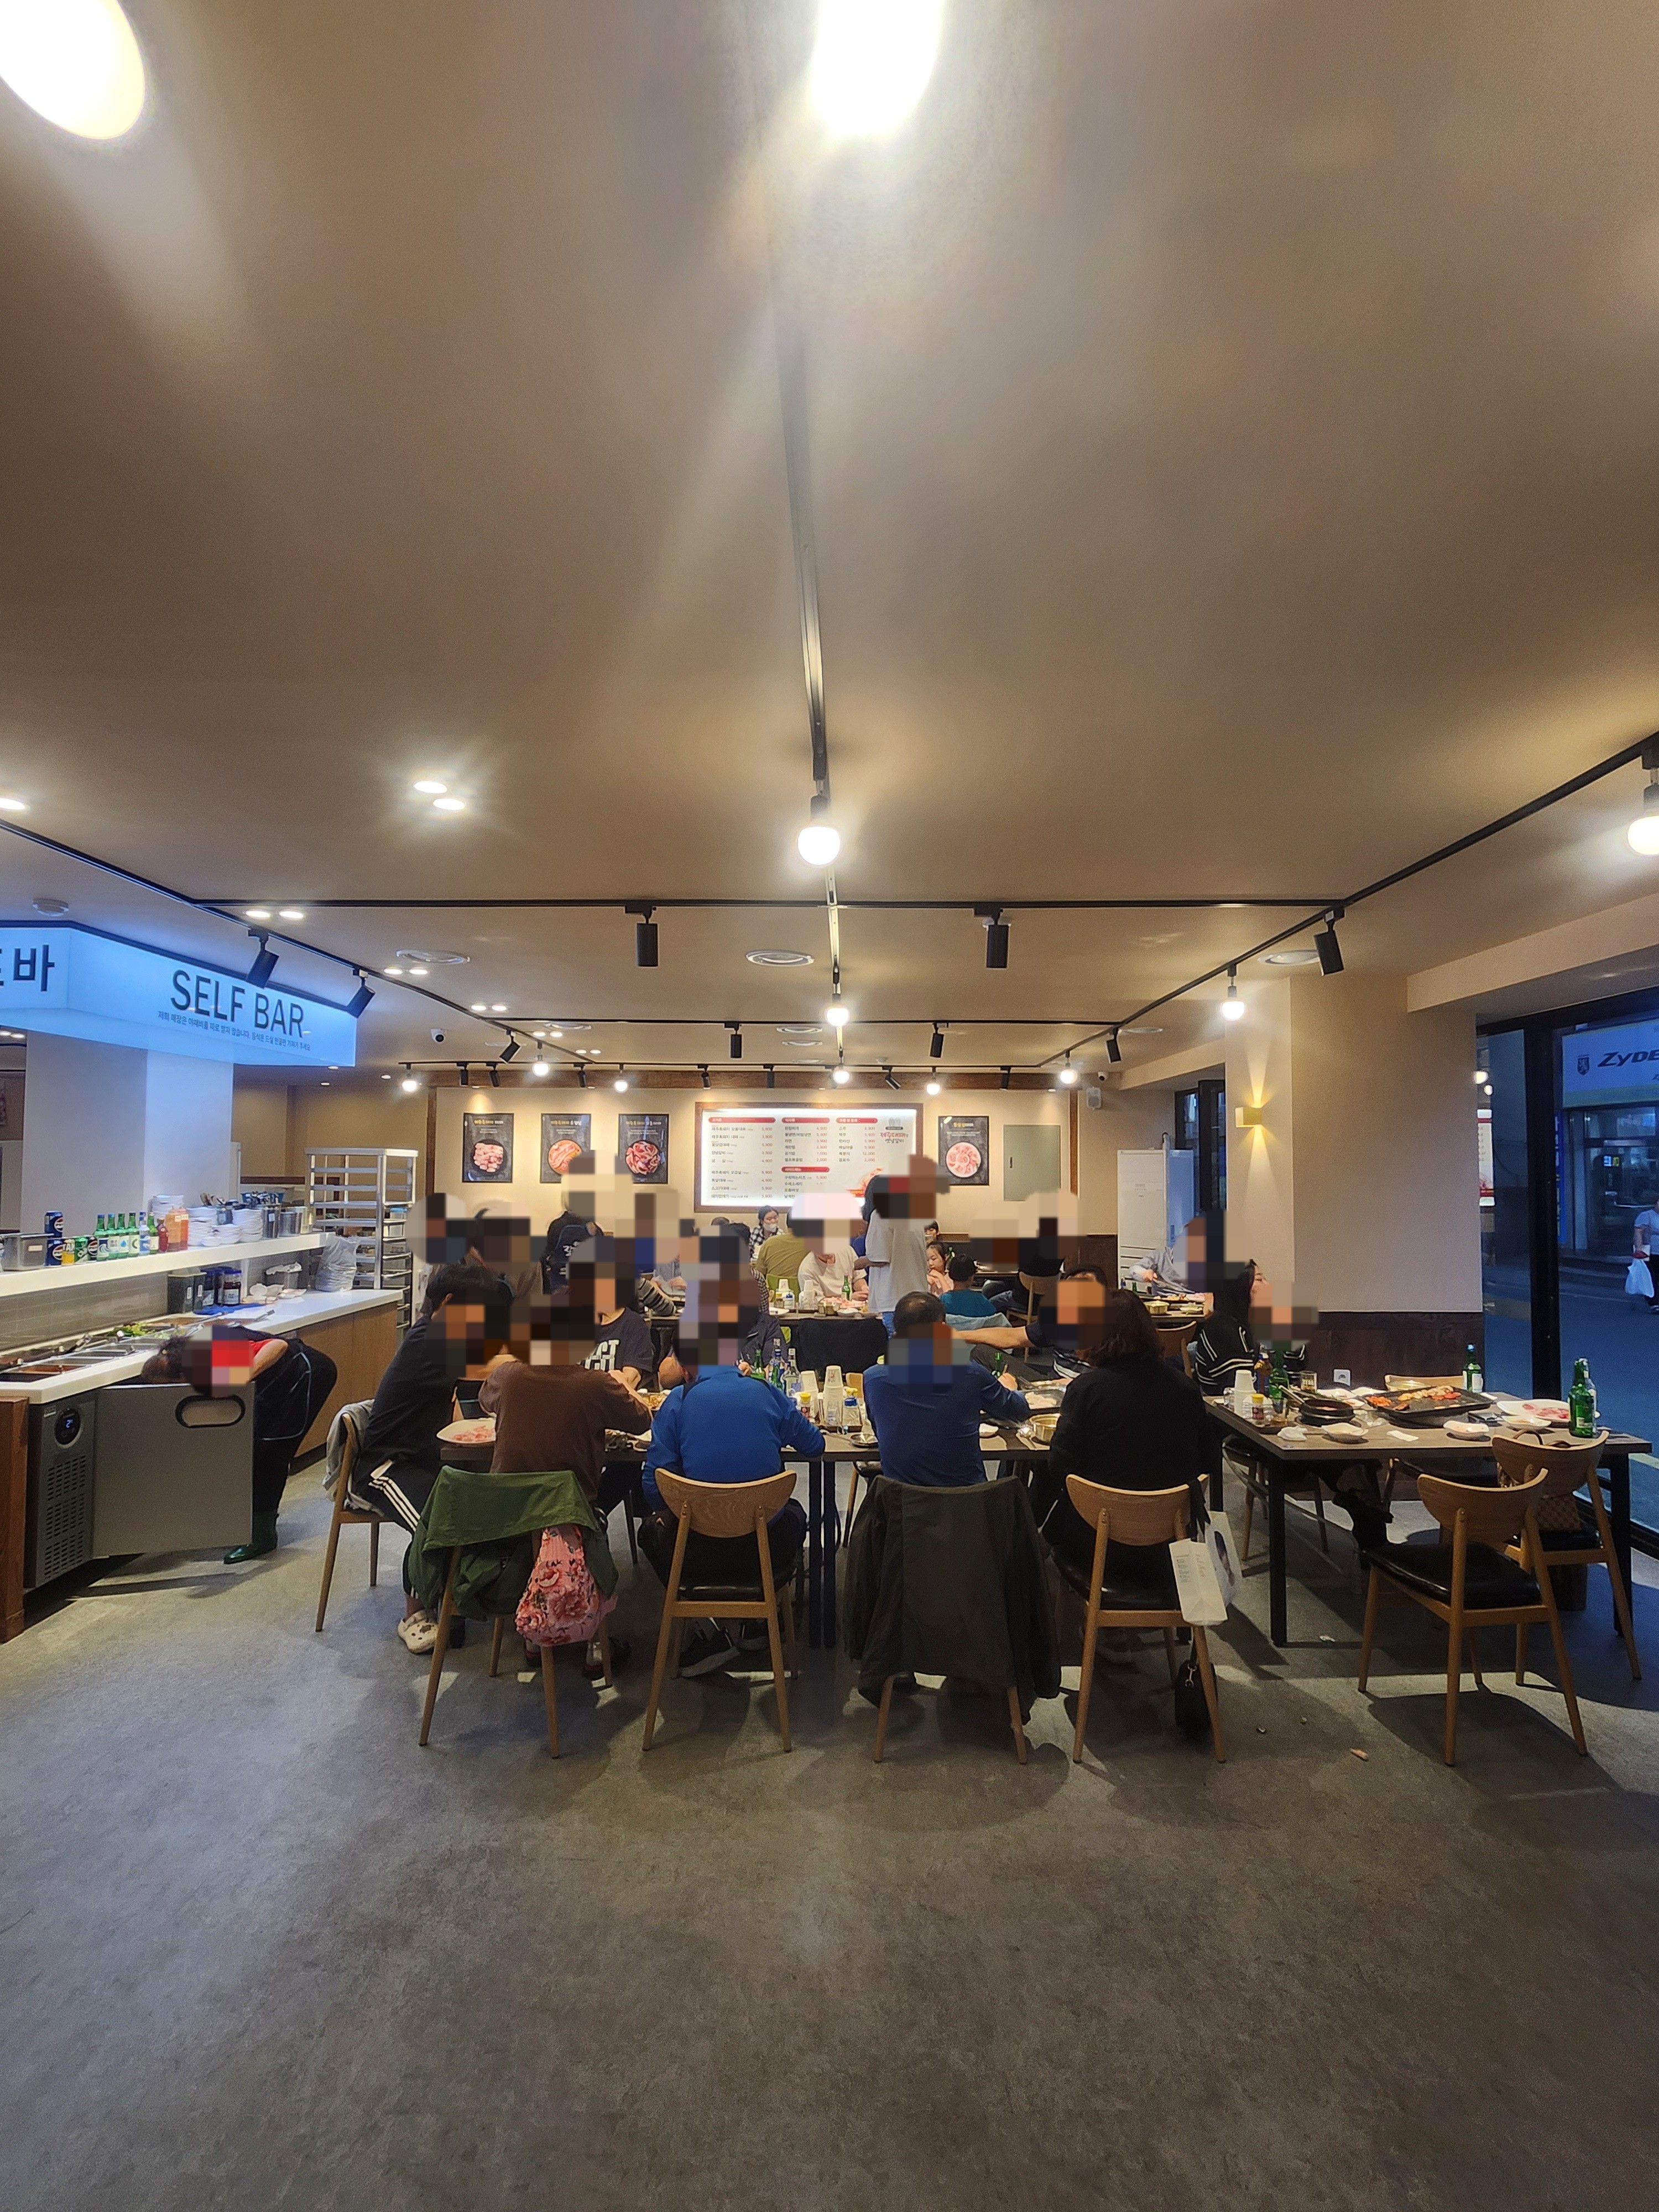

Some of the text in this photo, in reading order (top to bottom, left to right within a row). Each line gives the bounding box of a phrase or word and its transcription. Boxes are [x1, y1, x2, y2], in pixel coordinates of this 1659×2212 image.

[0, 944, 55, 992] 바
[158, 1011, 169, 1022] 저희
[210, 1022, 220, 1032] 따로
[170, 969, 304, 1039] SELF BAR
